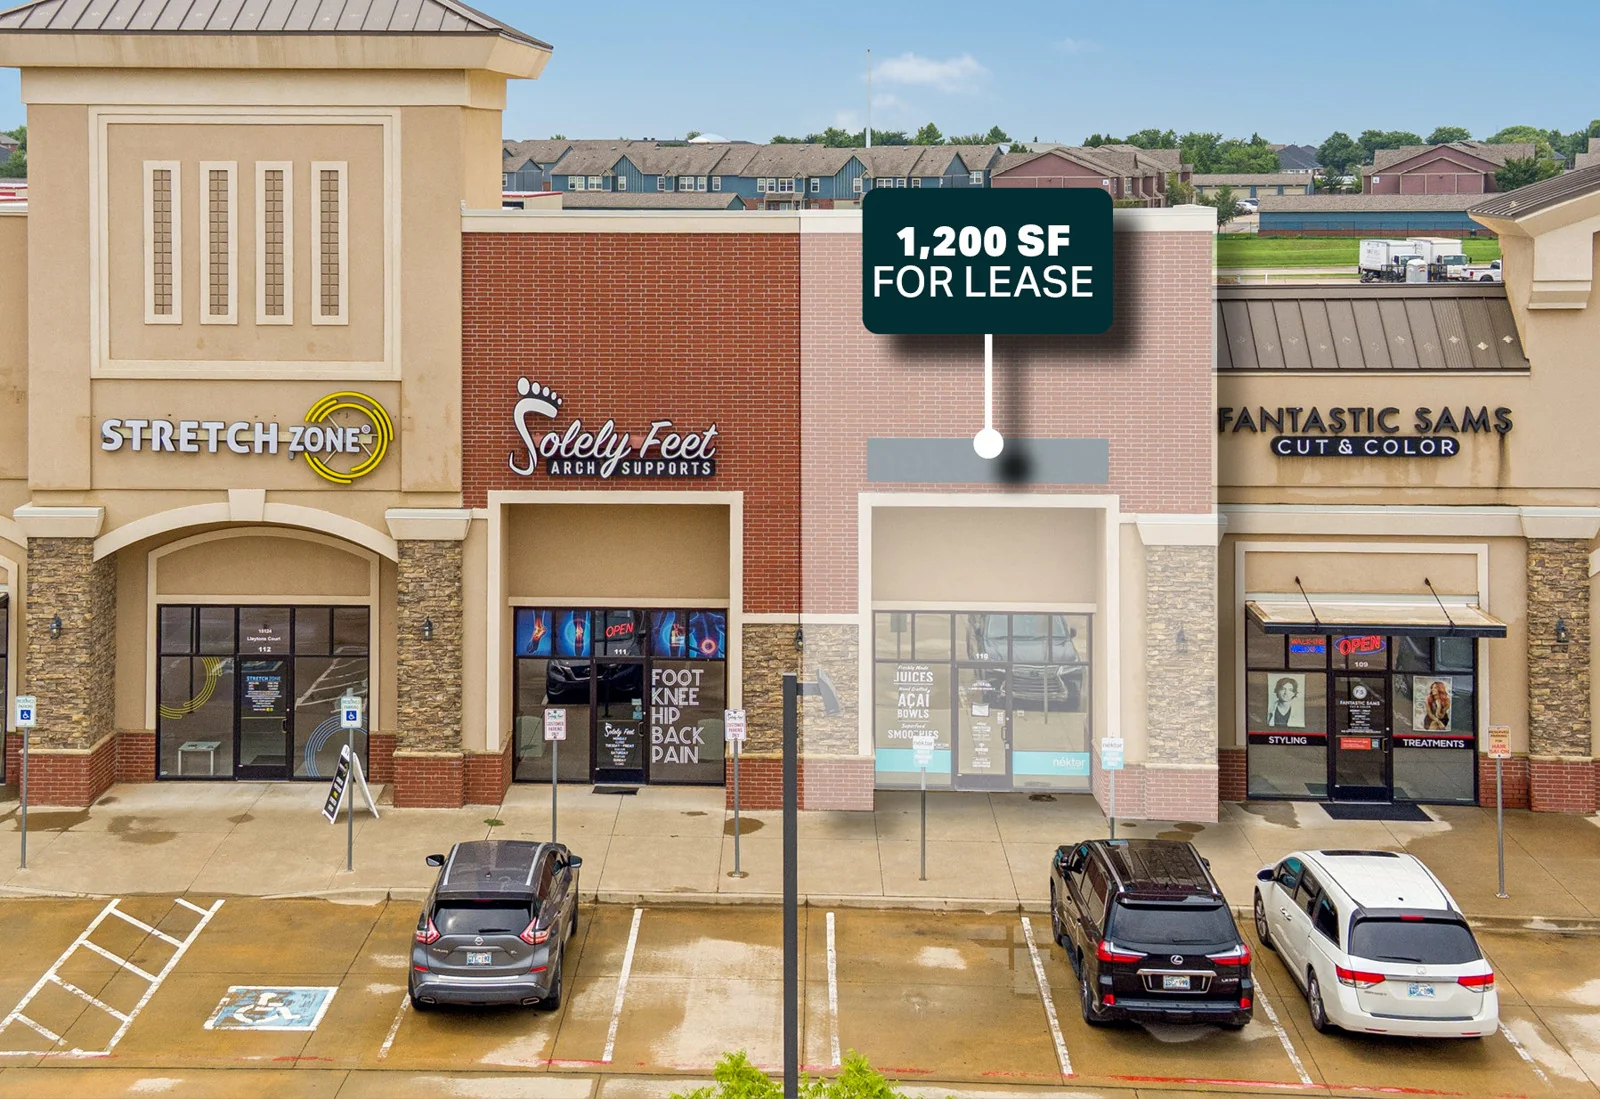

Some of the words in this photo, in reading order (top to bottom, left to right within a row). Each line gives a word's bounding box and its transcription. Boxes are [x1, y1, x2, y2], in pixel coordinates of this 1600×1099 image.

[1218, 406, 1400, 434] FANTASTIC
[1414, 406, 1514, 434] SAMS
[101, 419, 279, 454] STRETCH
[288, 426, 361, 453] ZONE
[508, 396, 632, 479] Solely
[639, 418, 719, 460] Feet
[1277, 439, 1329, 455] CUT
[1338, 439, 1353, 455] &
[1364, 439, 1455, 455] COLOR
[551, 461, 596, 475] ARCH
[621, 461, 712, 475] SUPPORTS
[605, 622, 635, 638] OPEN
[1339, 635, 1381, 656] OPEN
[651, 669, 705, 687] FOOT
[893, 671, 934, 682] JUICES
[651, 687, 700, 706] KNEE
[651, 706, 681, 725] HIP
[897, 709, 930, 719] BOWLS
[651, 726, 706, 745] BACK
[1268, 736, 1308, 745] STYLING
[1403, 738, 1465, 748] TREATMENTS
[651, 745, 700, 764] PAIN
